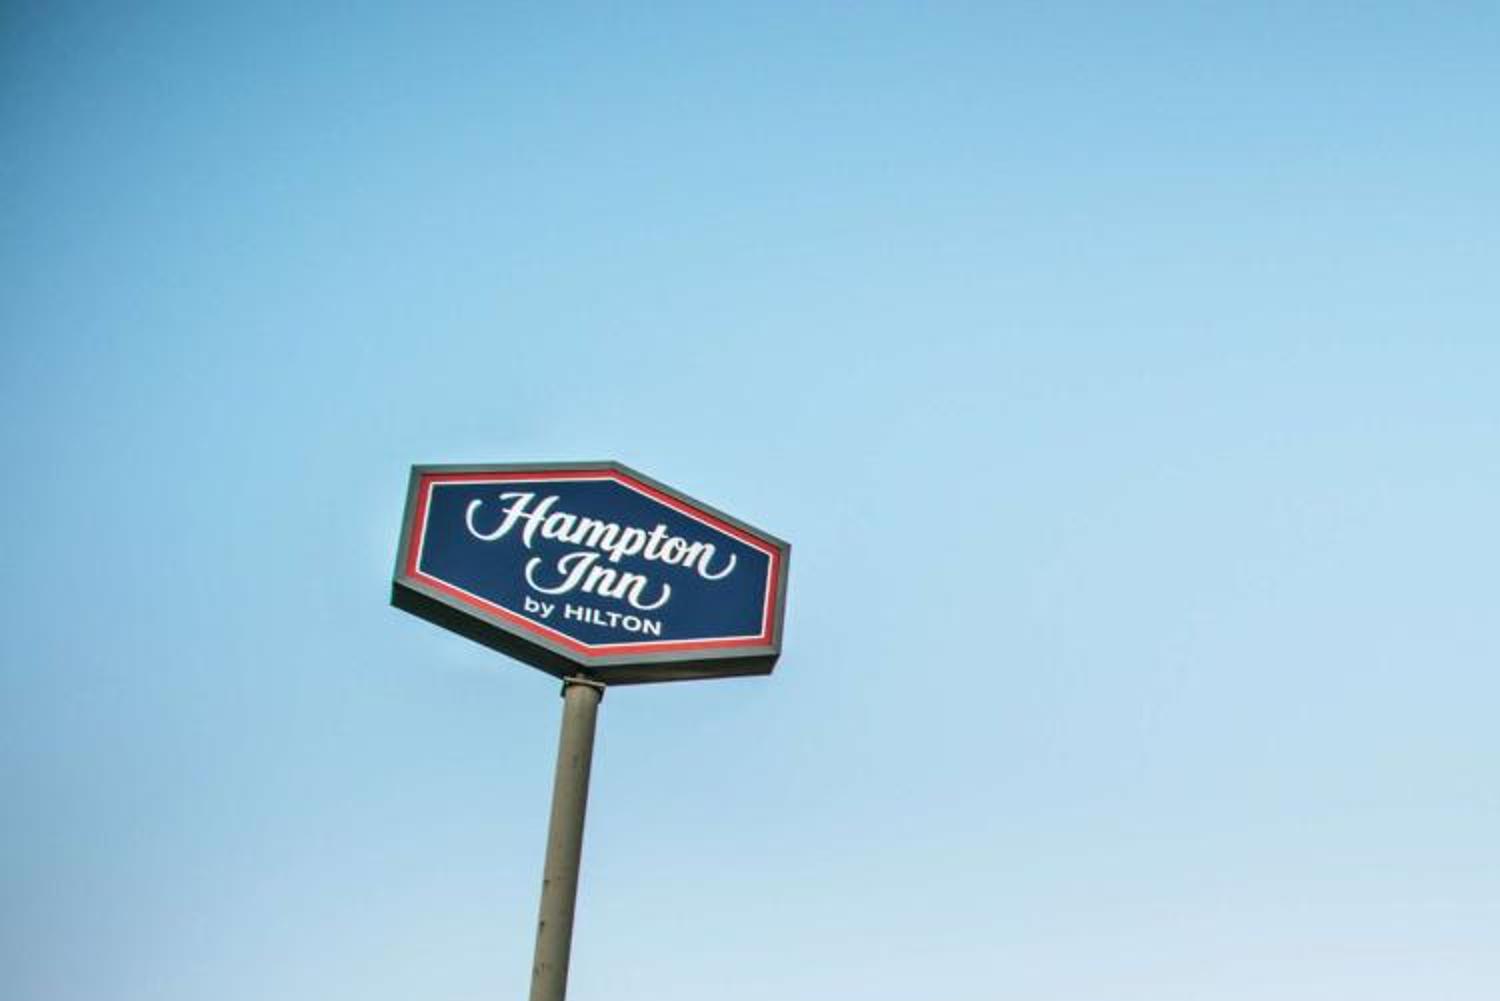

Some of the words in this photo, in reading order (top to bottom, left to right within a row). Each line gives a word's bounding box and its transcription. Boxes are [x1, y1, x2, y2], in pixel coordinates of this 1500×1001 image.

[465, 491, 737, 581] Hampton
[524, 550, 671, 611] Inn
[523, 595, 557, 619] by
[563, 602, 663, 637] HILTON
